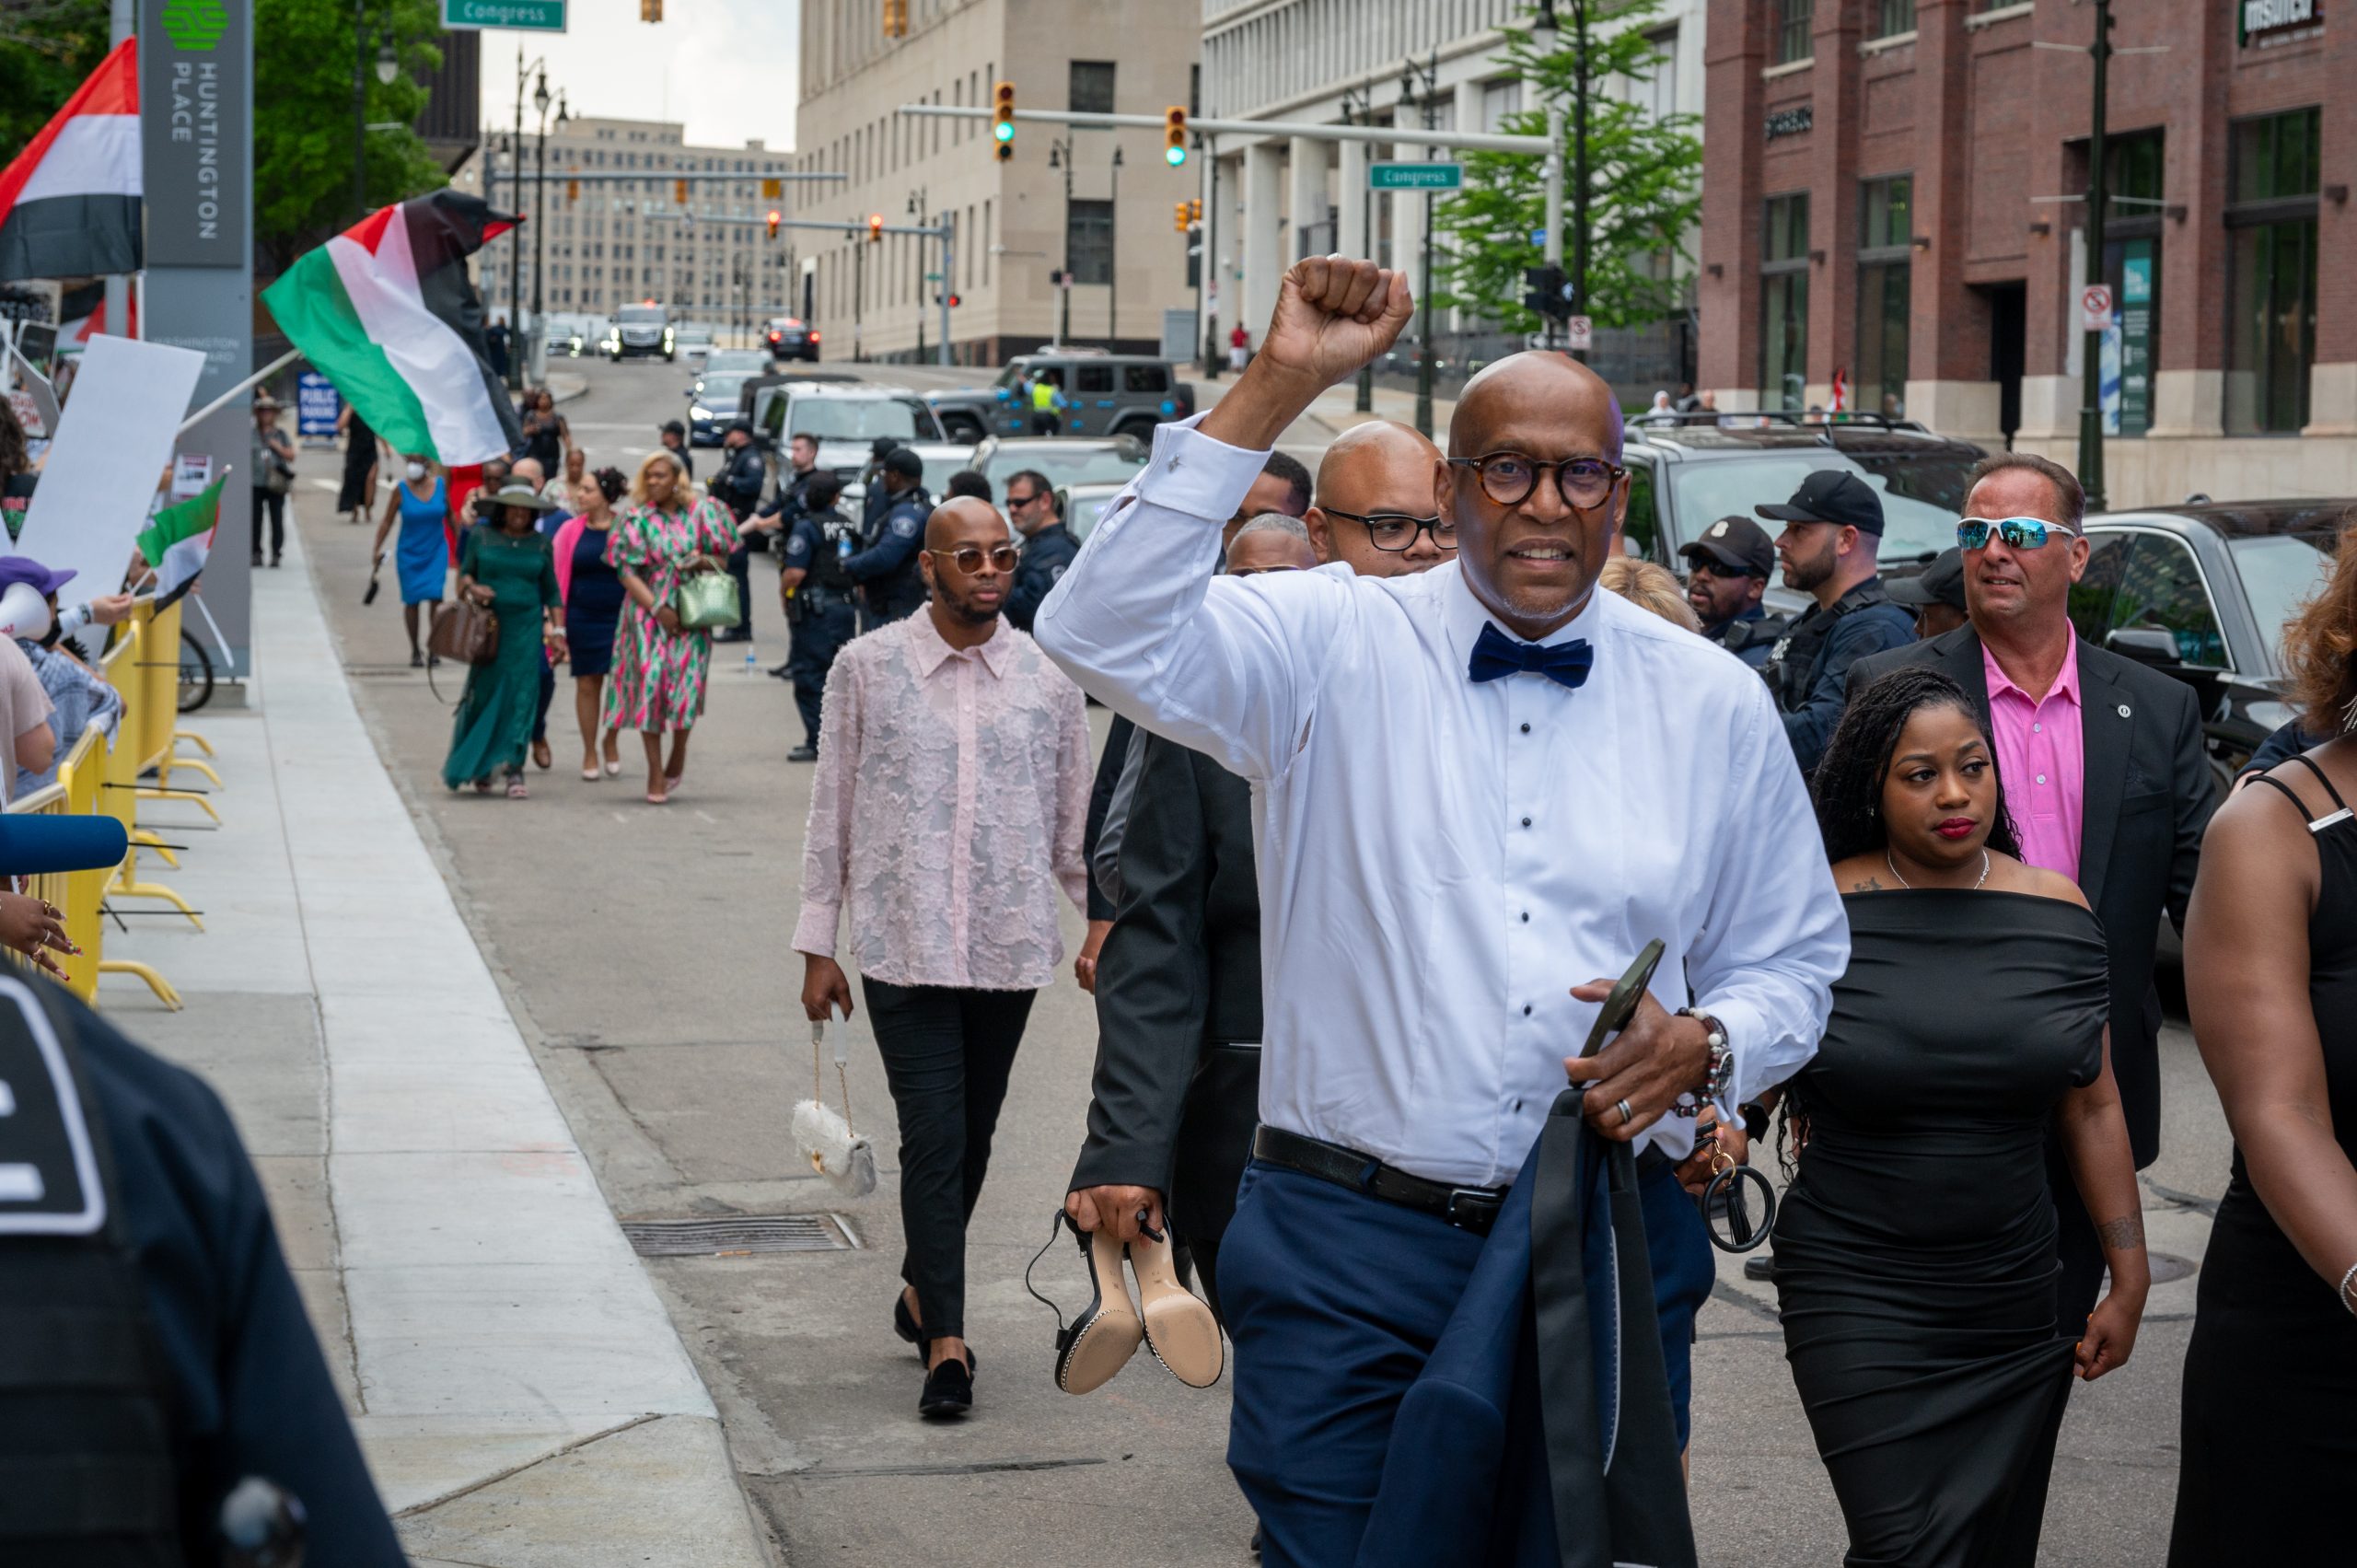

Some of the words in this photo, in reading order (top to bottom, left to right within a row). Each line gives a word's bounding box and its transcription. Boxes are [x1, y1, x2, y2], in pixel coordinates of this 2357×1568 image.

[463, 1, 545, 26] Congress
[171, 62, 192, 143] PLACE
[197, 62, 219, 239] HUNTINGTON
[1383, 168, 1447, 186] Congress
[300, 387, 338, 403] PUBLIC
